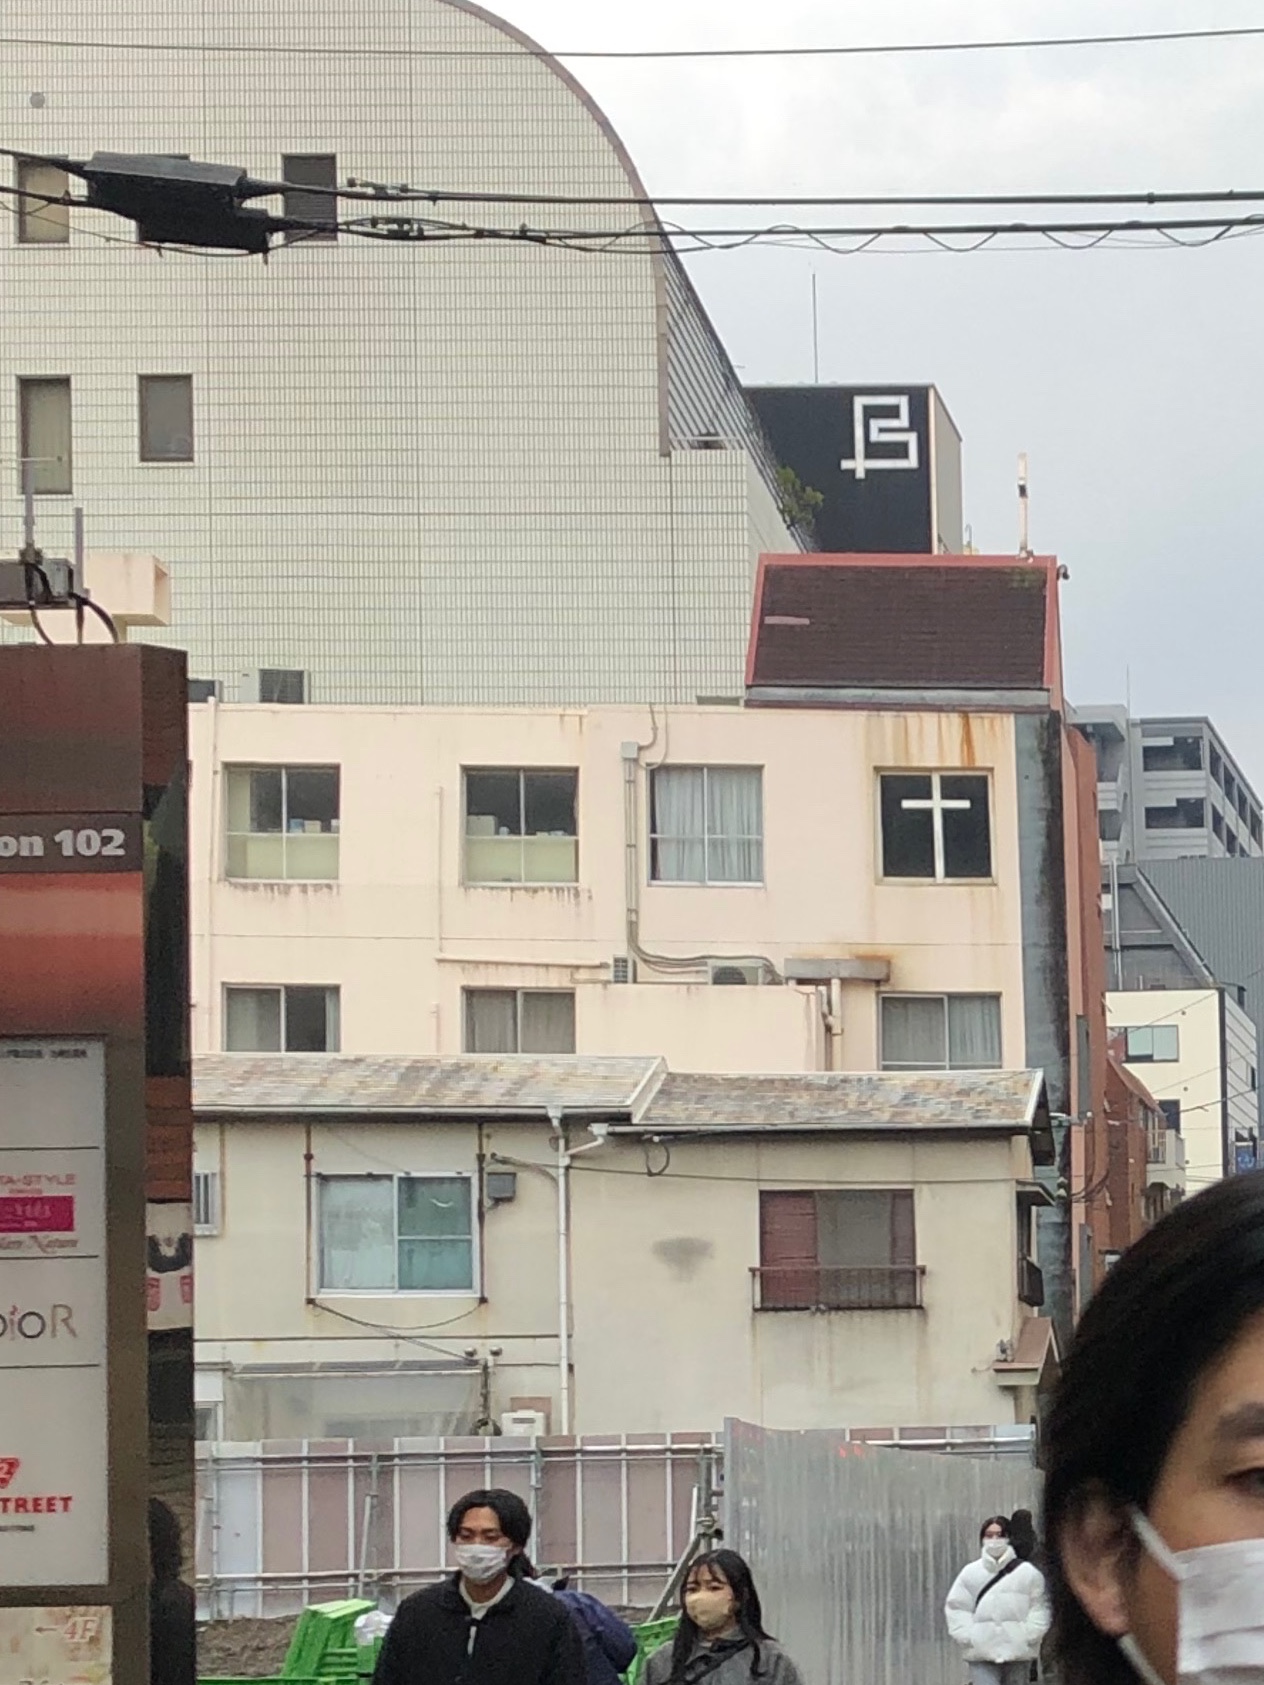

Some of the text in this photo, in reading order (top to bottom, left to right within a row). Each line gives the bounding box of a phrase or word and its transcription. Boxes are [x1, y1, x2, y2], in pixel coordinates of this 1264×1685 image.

[0, 829, 126, 857] on 102
[65, 1618, 98, 1640] 4F
